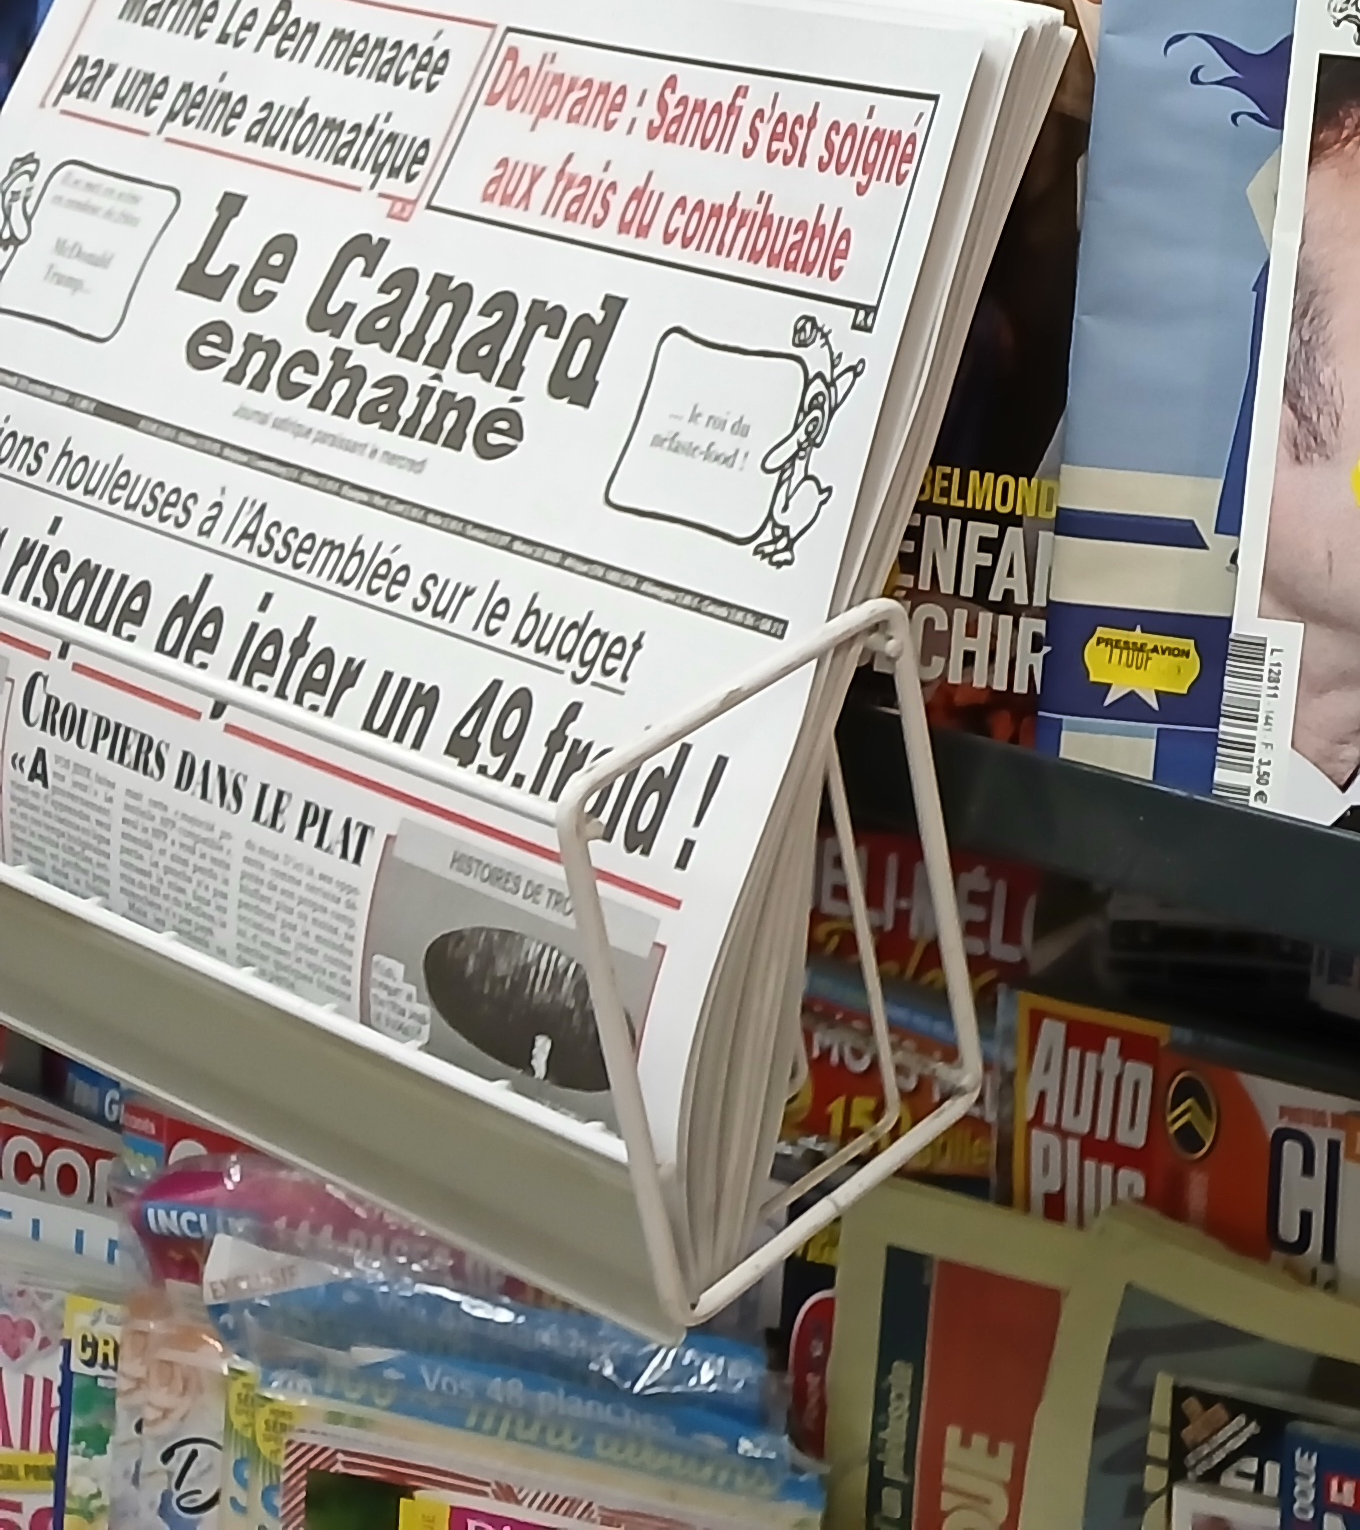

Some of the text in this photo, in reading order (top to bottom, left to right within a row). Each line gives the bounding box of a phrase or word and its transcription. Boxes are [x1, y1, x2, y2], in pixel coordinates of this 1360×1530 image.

[315, 26, 451, 93] menacée
[484, 46, 749, 155] Doliprane Sanofi
[663, 191, 851, 283] contribuable
[175, 190, 629, 410] Le Canard
[185, 319, 524, 462] enchaîné
[511, 591, 645, 686] budget
[21, 669, 375, 867] CROUPIERS PLAT
[1026, 1019, 1154, 1147] Auto
